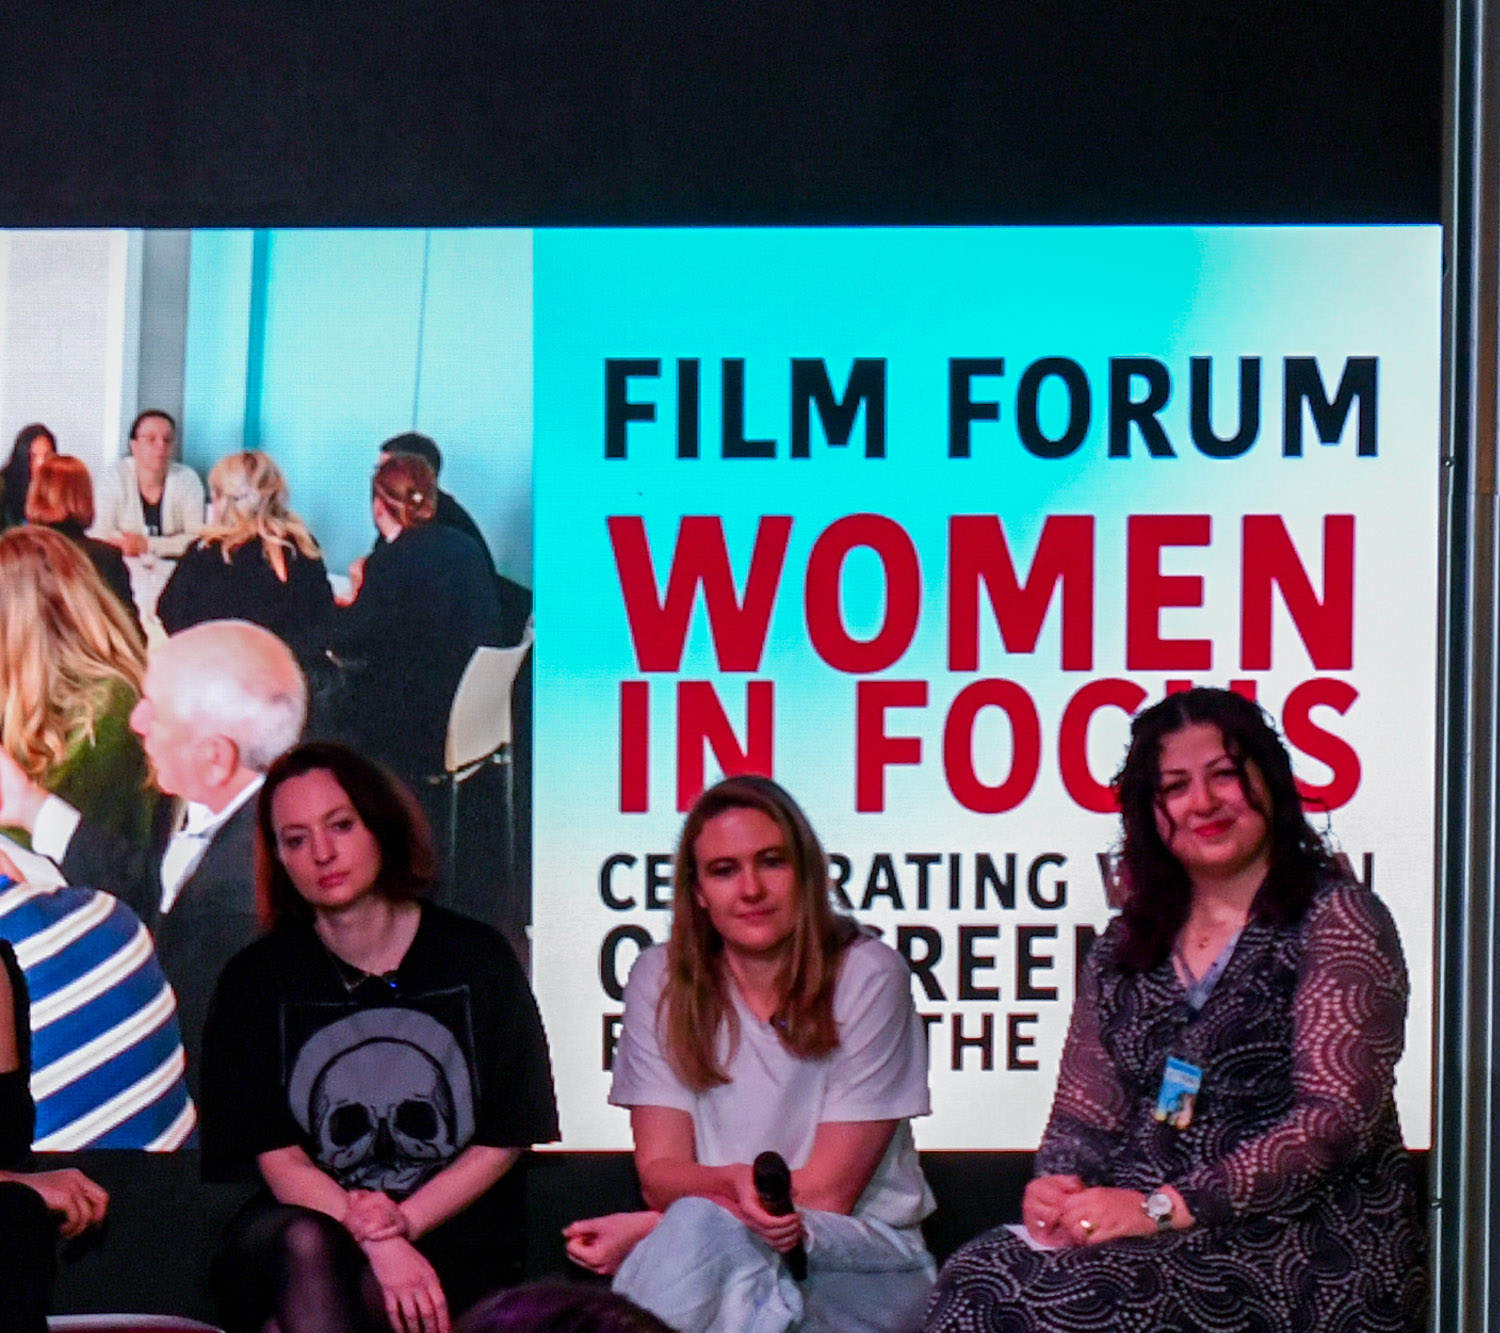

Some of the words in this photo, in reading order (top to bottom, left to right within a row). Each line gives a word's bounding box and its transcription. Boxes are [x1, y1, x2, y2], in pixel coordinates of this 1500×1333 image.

[604, 357, 887, 459] FILM
[947, 355, 1380, 459] FORUM
[606, 513, 1355, 673] WOMEN
[618, 680, 775, 812] IN
[855, 677, 1363, 813] FOCS
[600, 852, 1068, 911] CERATING
